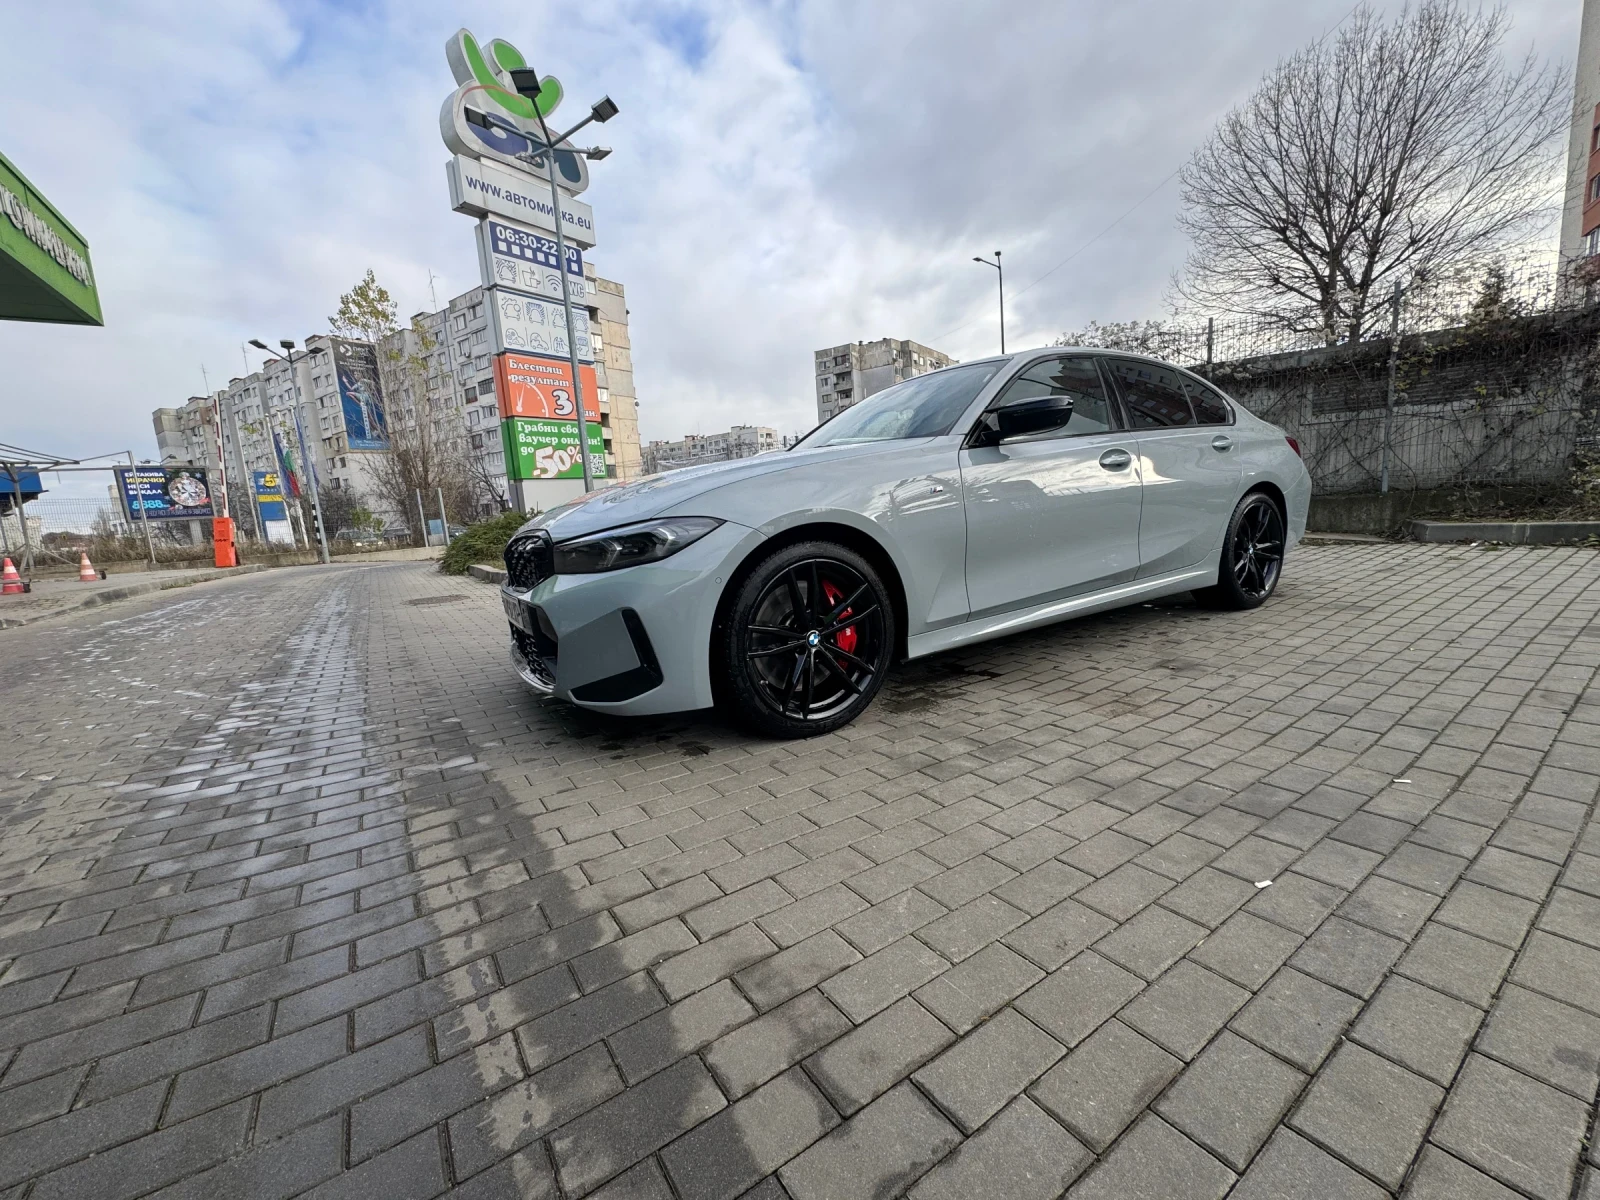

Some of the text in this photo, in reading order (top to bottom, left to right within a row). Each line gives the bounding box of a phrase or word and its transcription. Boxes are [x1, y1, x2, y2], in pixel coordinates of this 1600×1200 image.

[465, 175, 591, 230] www.автомика.eu
[495, 226, 577, 261] 06:30-2200
[569, 281, 585, 299] WC
[508, 359, 564, 376] Блестящ
[510, 374, 570, 387] резултат
[552, 389, 574, 416] 3
[517, 421, 579, 434] Грабни сво
[520, 446, 535, 456] до
